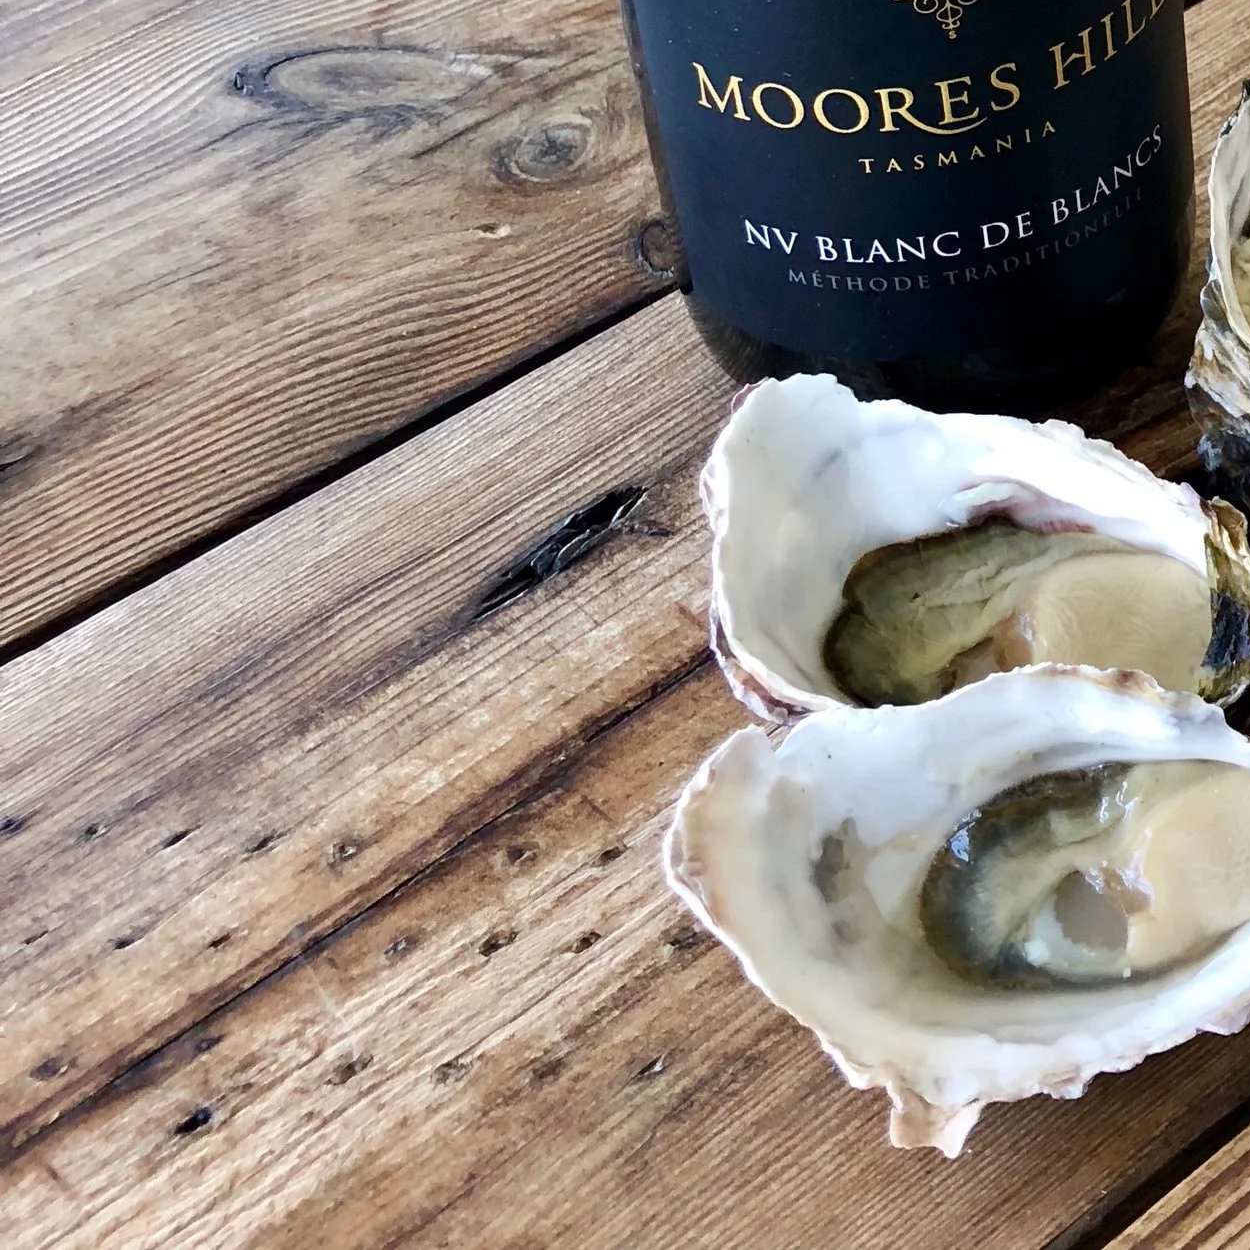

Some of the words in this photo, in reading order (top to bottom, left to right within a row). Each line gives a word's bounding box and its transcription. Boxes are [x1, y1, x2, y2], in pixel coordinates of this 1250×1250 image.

[692, 61, 1021, 135] MOORES
[859, 120, 1056, 174] TASMANIA
[744, 218, 799, 254] NV
[816, 231, 962, 264] BLANC
[980, 212, 1034, 250] DE
[1050, 124, 1162, 225] BLANCS
[788, 269, 930, 292] MÉTHODE
